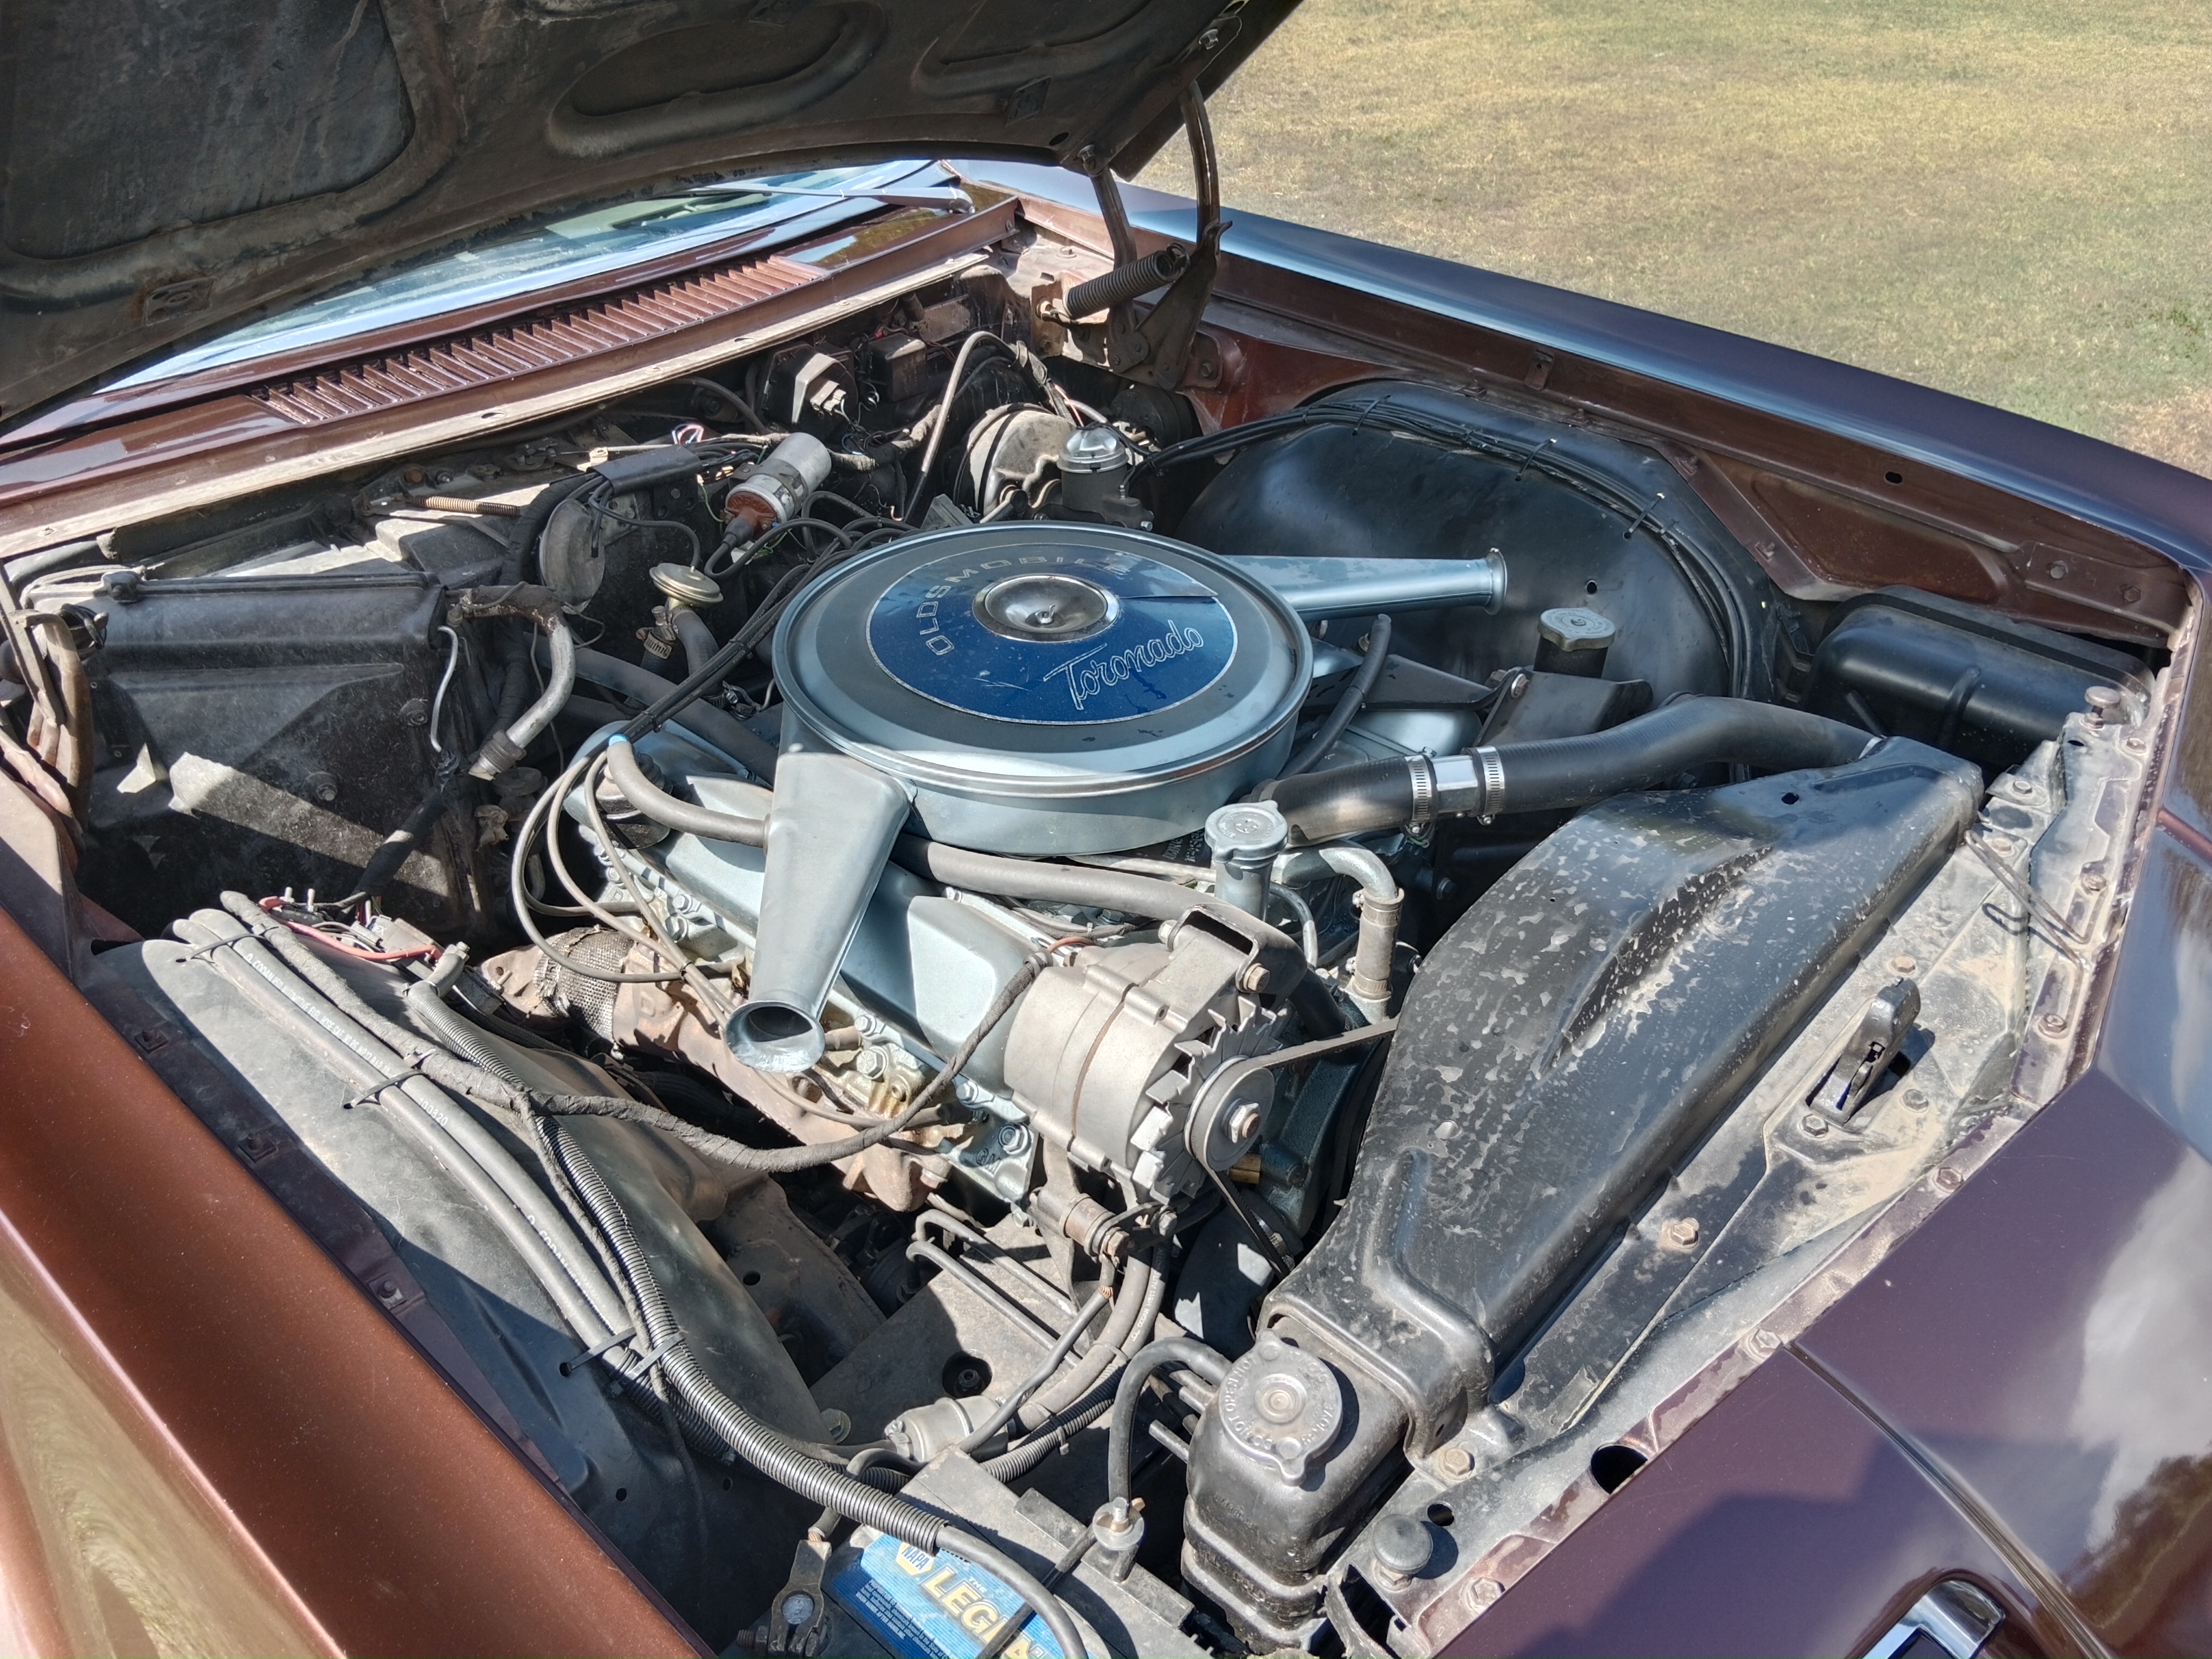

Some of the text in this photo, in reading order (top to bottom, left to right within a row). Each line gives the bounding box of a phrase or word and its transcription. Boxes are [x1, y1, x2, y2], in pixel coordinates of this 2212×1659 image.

[916, 556, 1131, 655] OLDSMOBILE
[1043, 619, 1204, 710] Toronado
[253, 960, 275, 983] CODAN
[419, 1098, 448, 1126] 100820
[976, 1148, 1002, 1175] GM
[1232, 1354, 1257, 1377] HOT
[1224, 1377, 1239, 1413] OPEN
[1228, 1416, 1253, 1442] NOT
[901, 1545, 930, 1571] NAPA
[869, 1578, 893, 1602] PROPOSITION
[968, 1576, 987, 1593] THE
[856, 1591, 867, 1604] WASH
[865, 1600, 879, 1614] HANDS
[876, 1611, 889, 1624] AFTER
[865, 1583, 874, 1593] lead
[891, 1608, 910, 1626] chemicals
[908, 1623, 921, 1636] known
[922, 1636, 930, 1645] the
[928, 1642, 940, 1654] State
[884, 1610, 893, 1619] also
[891, 1617, 905, 1631] contain
[903, 1628, 915, 1638] other
[912, 1636, 932, 1655] chemicals
